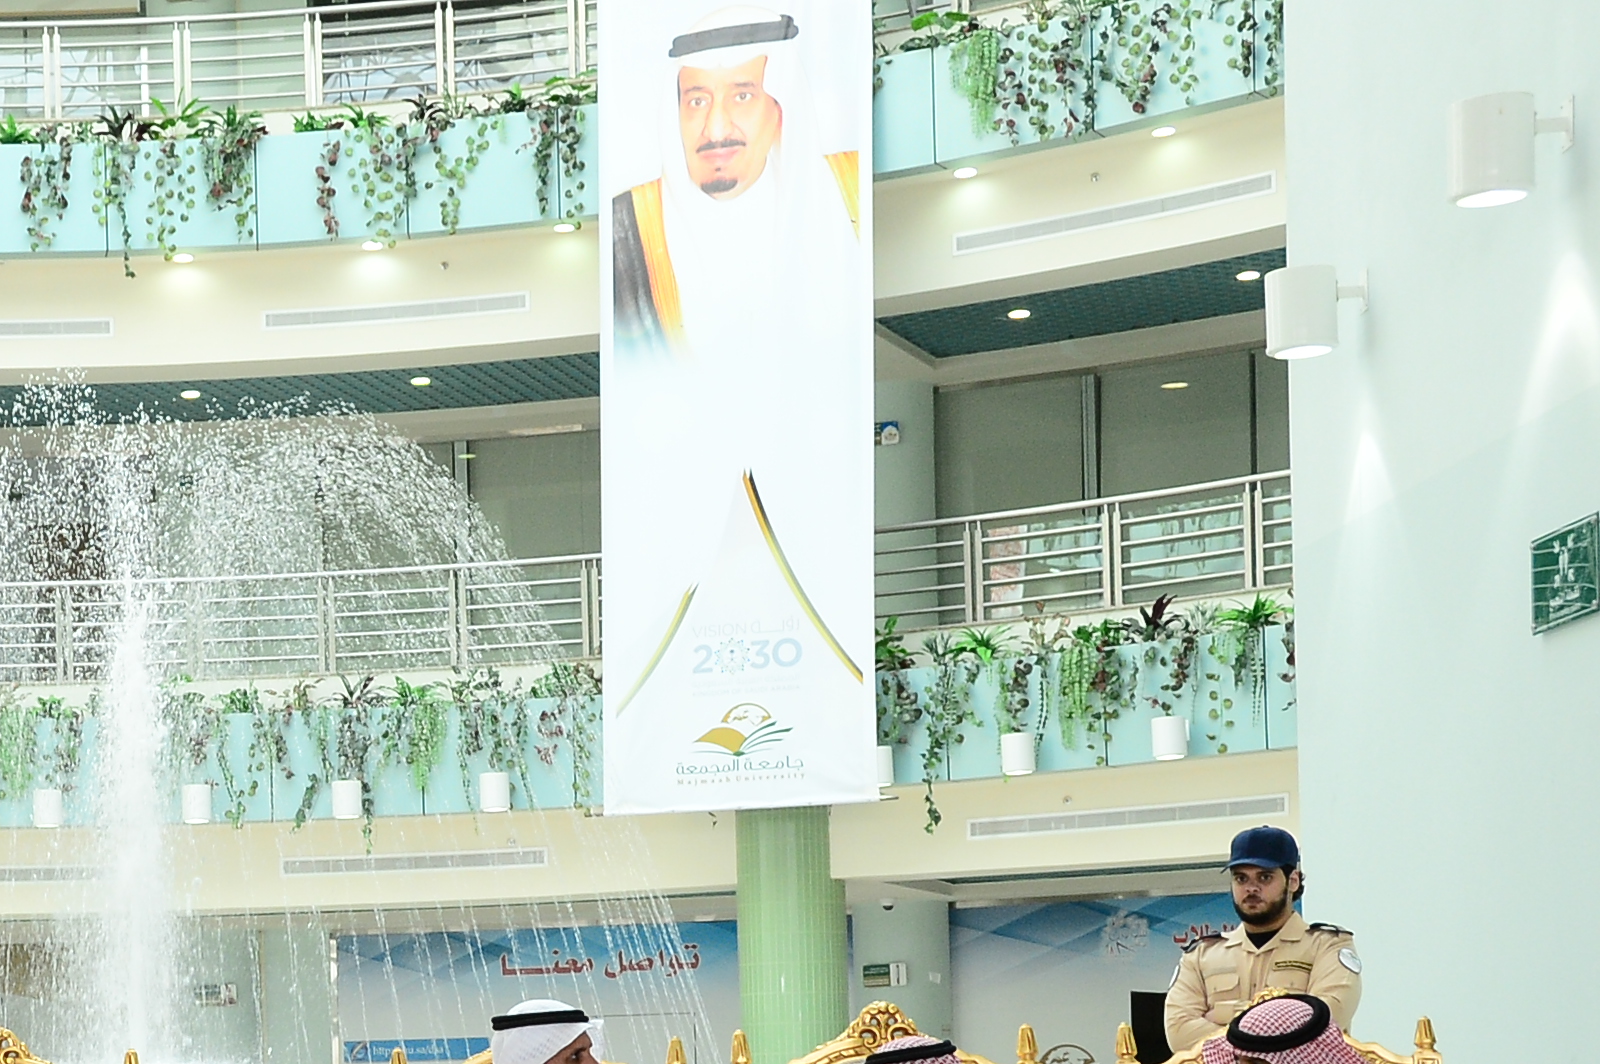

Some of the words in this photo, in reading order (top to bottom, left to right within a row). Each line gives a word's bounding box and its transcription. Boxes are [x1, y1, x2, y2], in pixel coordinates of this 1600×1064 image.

[691, 622, 747, 638] VISION
[675, 758, 740, 776] المجمعة
[743, 755, 804, 774] جامعة
[735, 771, 806, 783] University
[500, 949, 595, 976] معنا
[604, 943, 700, 979] تواصل
